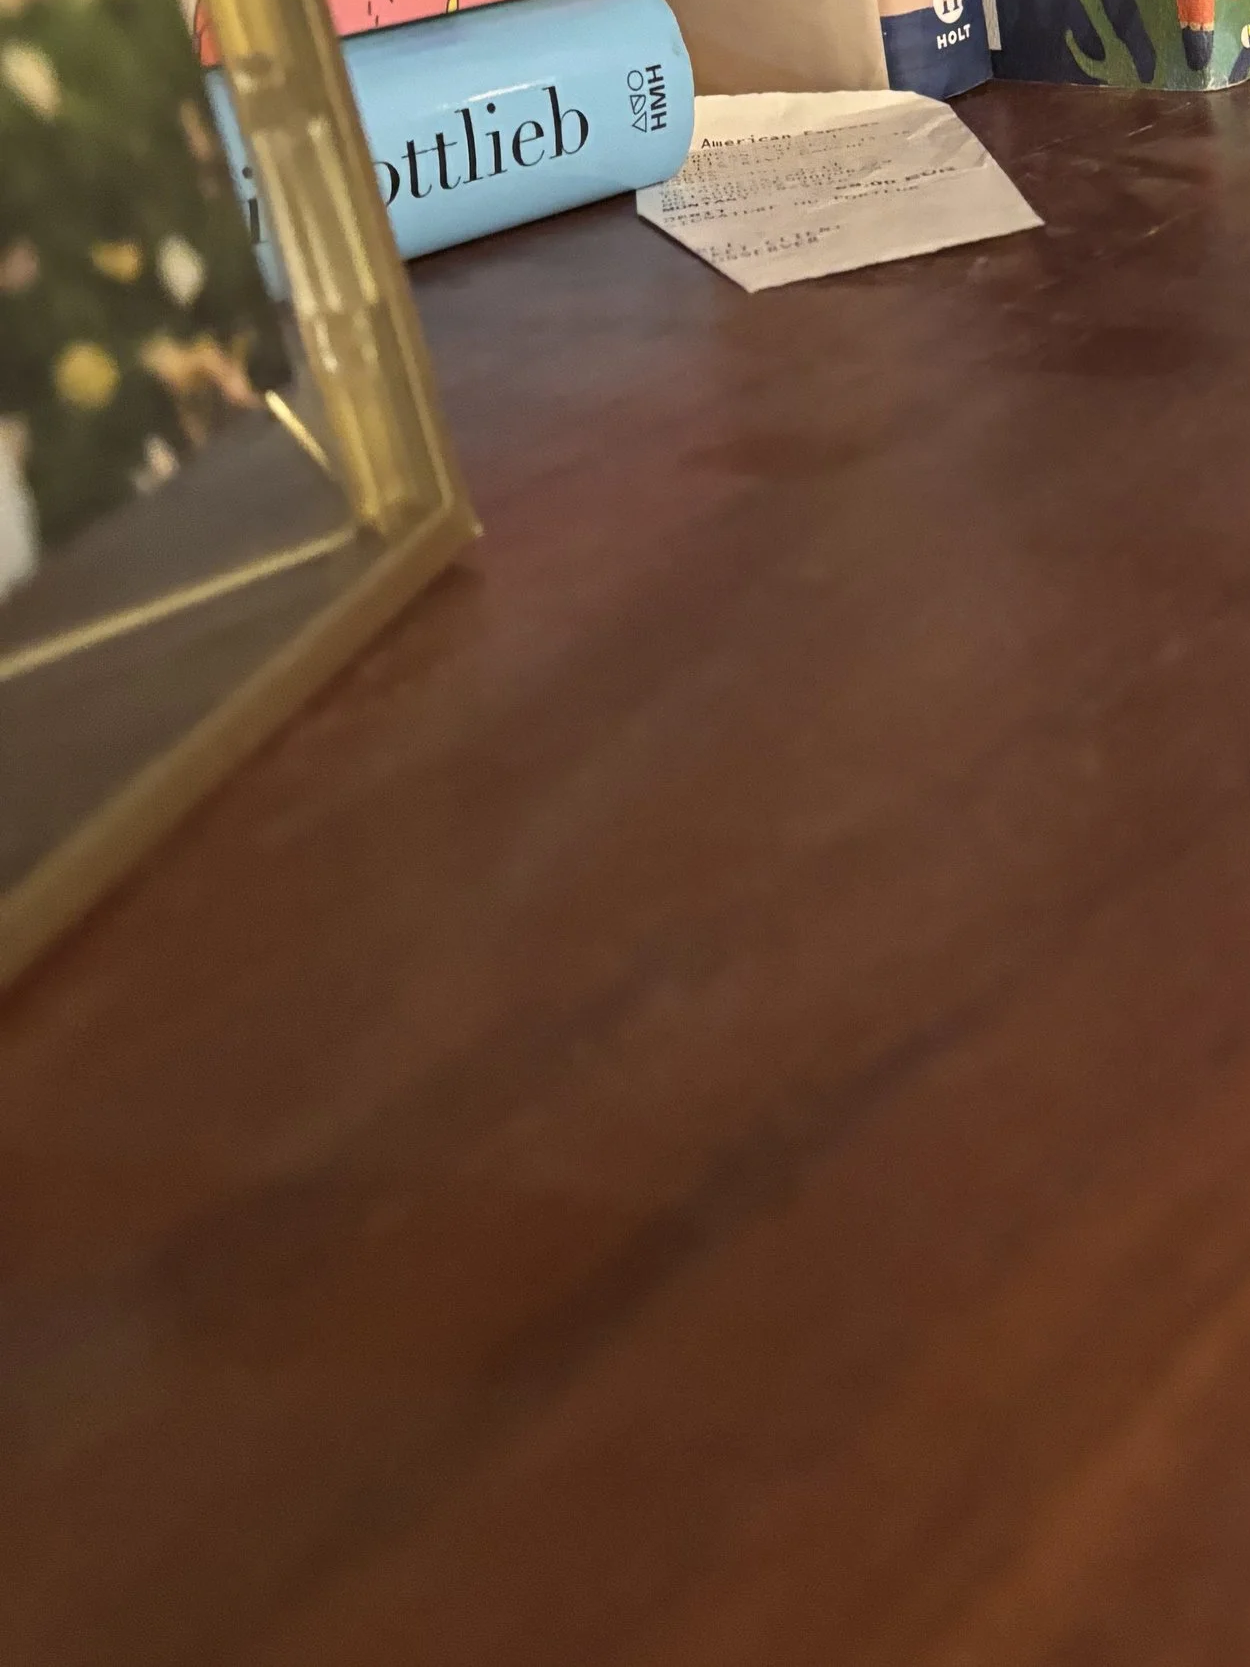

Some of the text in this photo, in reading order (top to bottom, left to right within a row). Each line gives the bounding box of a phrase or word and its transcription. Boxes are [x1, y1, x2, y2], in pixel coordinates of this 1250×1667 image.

[936, 23, 971, 50] HOLT
[645, 63, 667, 132] HMH
[374, 85, 589, 208] ottlieb
[700, 132, 793, 150] American
